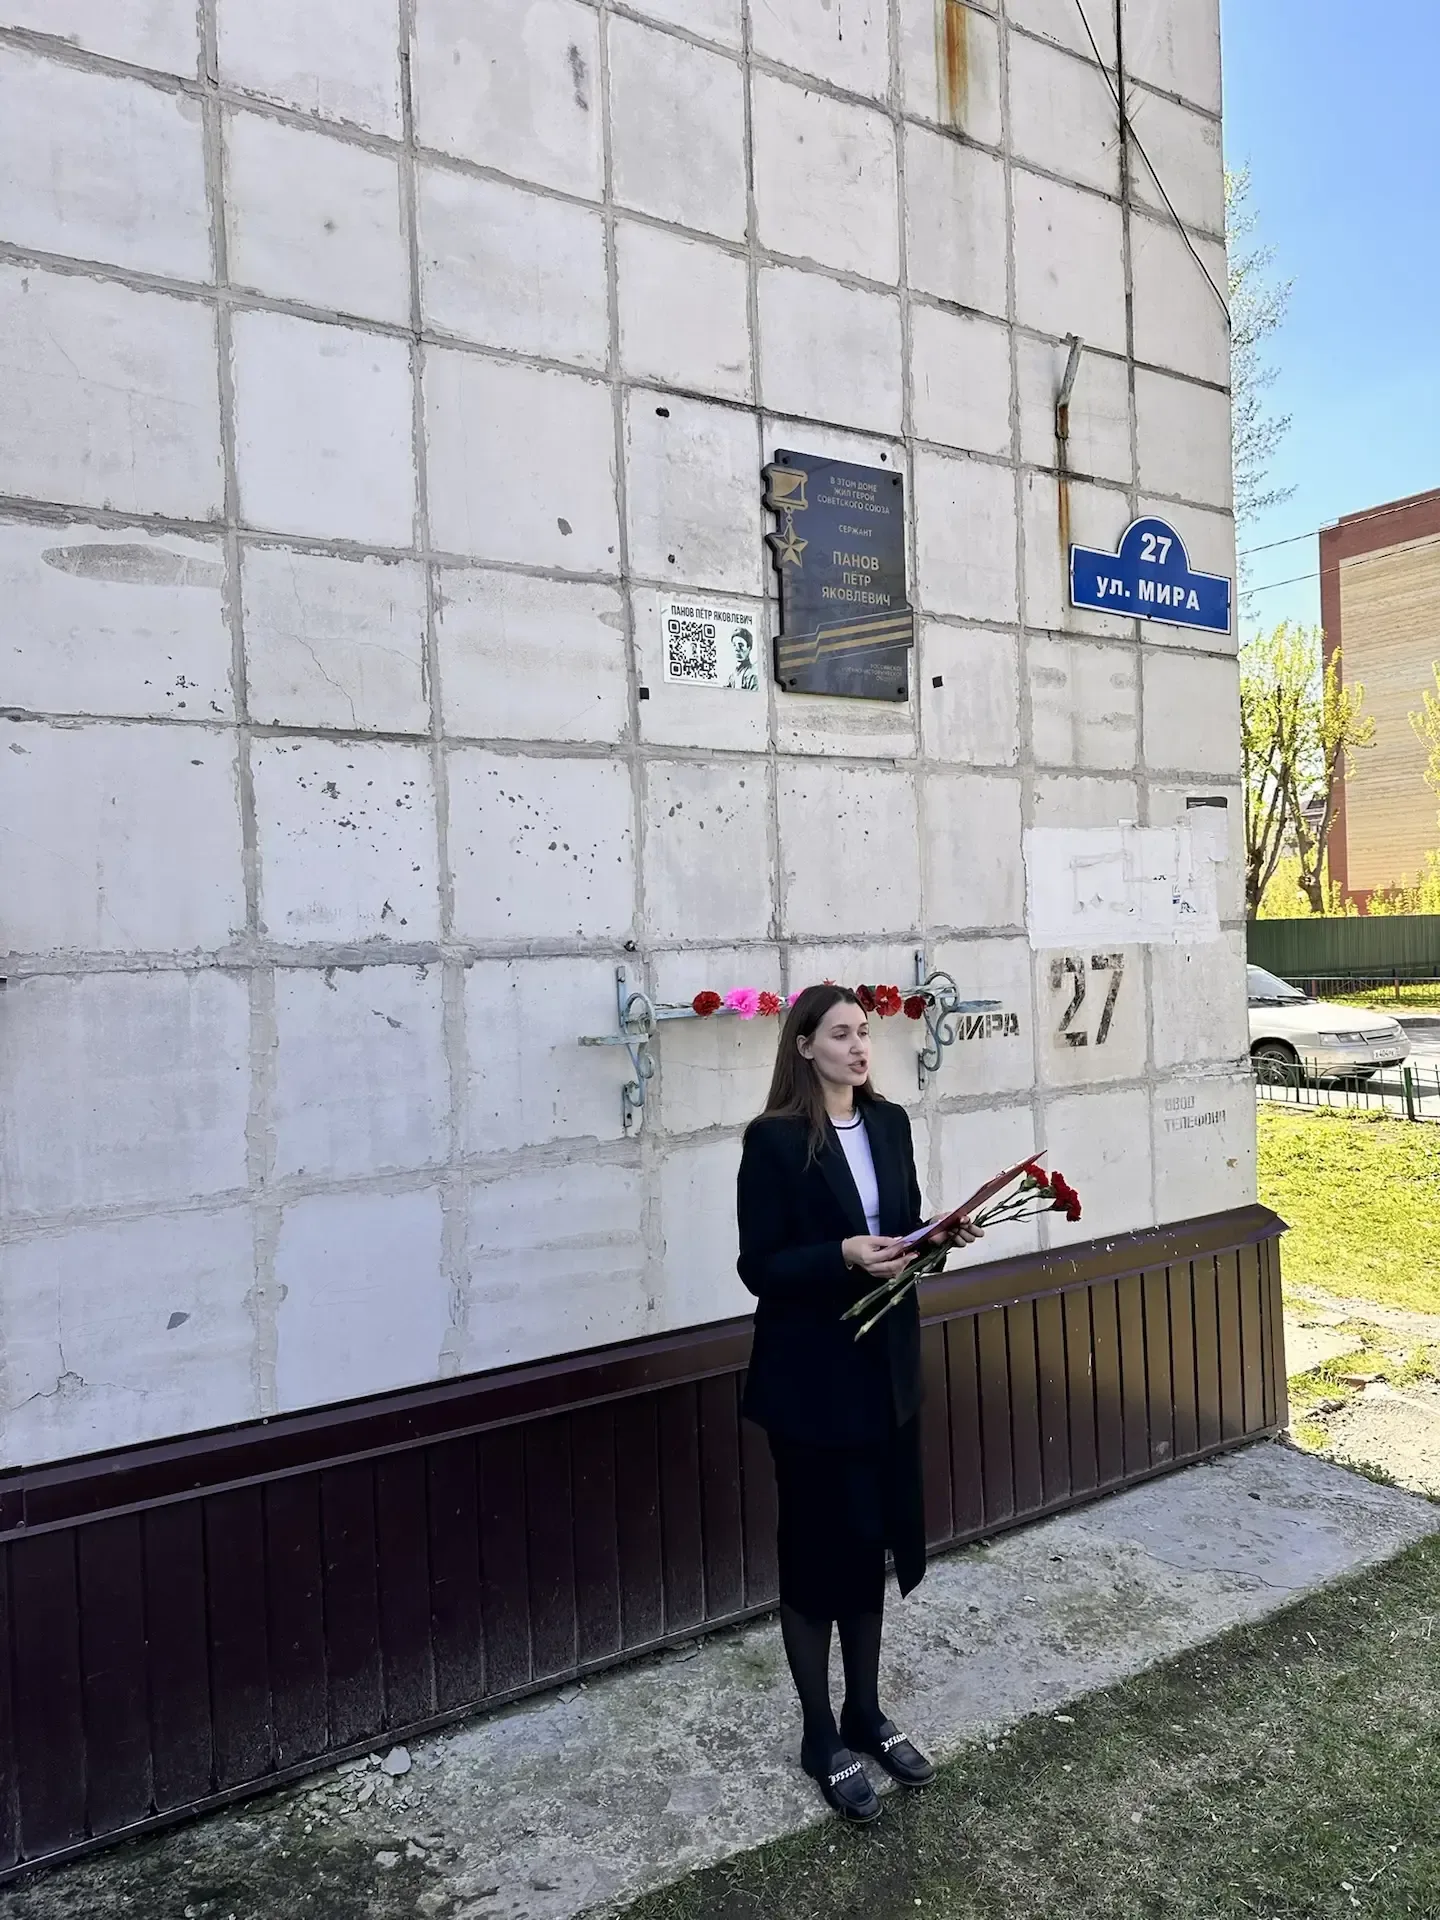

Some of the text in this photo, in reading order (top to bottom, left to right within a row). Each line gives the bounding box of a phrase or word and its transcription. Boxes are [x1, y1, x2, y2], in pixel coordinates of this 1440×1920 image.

[830, 476, 877, 493] В ЭТОМ ДОМЕ
[834, 487, 875, 502] ЖИЛ ГЕРОЙ
[817, 494, 890, 515] СОВЕТСКОГО СОЮЗА
[838, 524, 873, 537] СЕРЖАНТ
[1140, 532, 1173, 565] 27
[833, 550, 880, 571] ПАНОВ
[843, 569, 872, 587] ПЁТР
[821, 585, 891, 607] ЯКОВЛЕВИЧ
[1096, 576, 1200, 611] ул. МИРА
[671, 605, 695, 618] ПАНОВ
[713, 610, 753, 626] ЯКОВЛЕВИЧ
[1051, 953, 1124, 1047] 27
